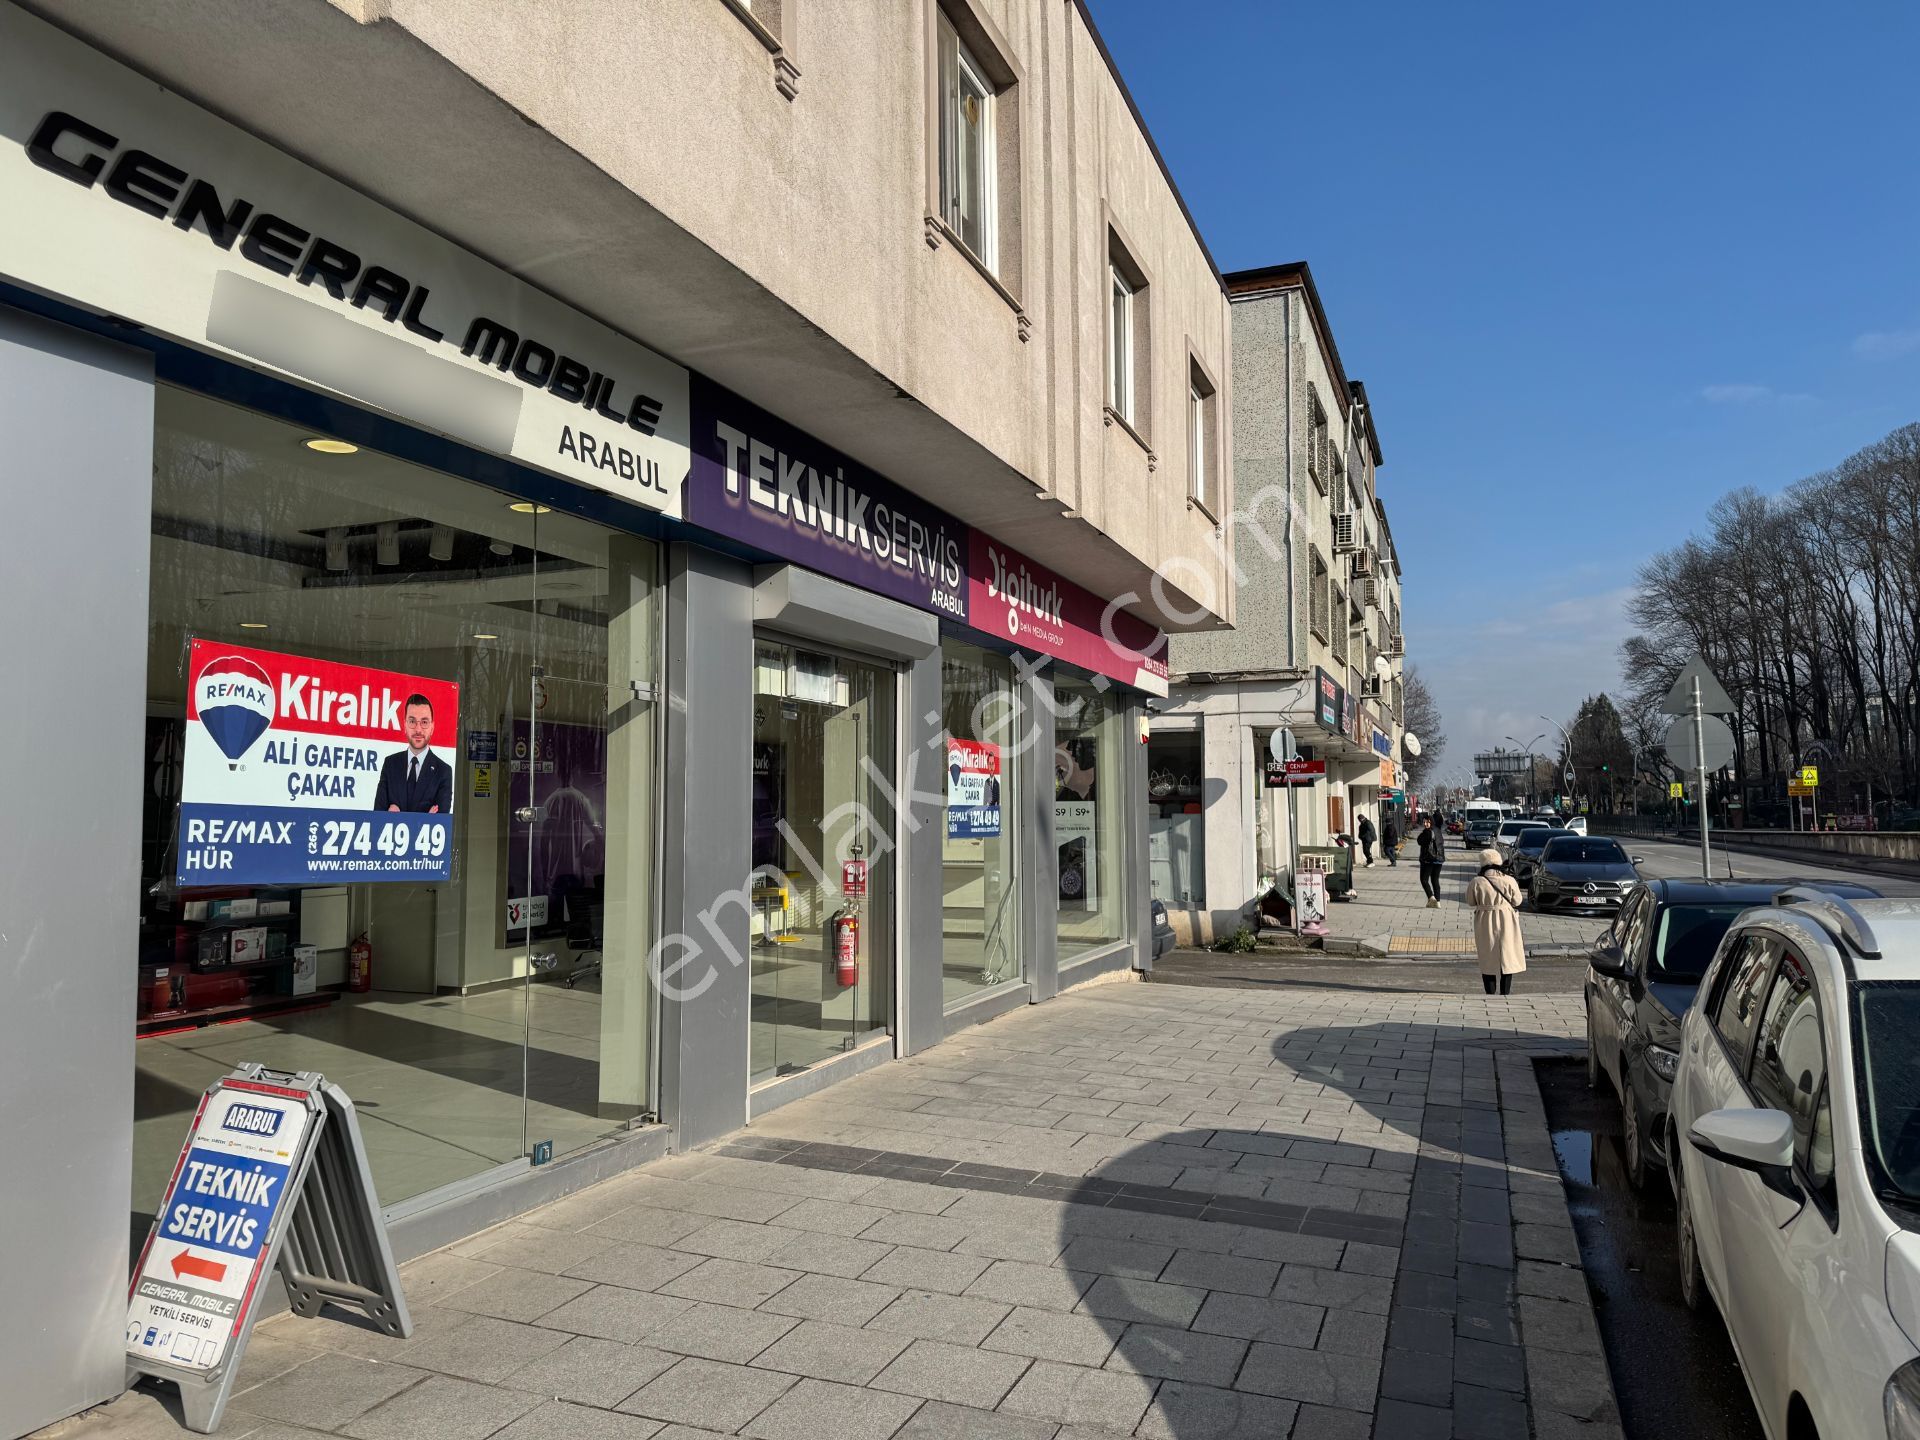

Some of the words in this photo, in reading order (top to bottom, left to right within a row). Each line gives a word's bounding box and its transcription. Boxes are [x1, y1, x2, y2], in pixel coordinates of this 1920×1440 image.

[25, 111, 443, 343] GENERAL
[461, 317, 663, 436] MOBILE
[558, 426, 668, 494] ARABUL
[716, 419, 871, 550] TEKNİK
[873, 503, 960, 588] SERVİS
[931, 588, 965, 617] ARABUL
[985, 546, 1063, 635] Digiturk
[1032, 626, 1048, 641] MEDIA
[1048, 633, 1064, 646] GROUP
[206, 683, 266, 706] RE/MAX
[280, 672, 402, 731] Kiralık
[263, 737, 298, 766] ALİ
[304, 743, 378, 772] GAFFAR
[963, 748, 988, 770] Kiralık
[287, 772, 355, 801] ÇAKAR
[187, 819, 292, 845] RE/MAX
[321, 821, 372, 857] 274
[377, 822, 409, 857] 49
[415, 823, 446, 857] 49
[186, 846, 233, 870] HÜR
[307, 857, 444, 871] www.remax.com.tr/hur
[225, 1106, 278, 1134] ARABUL
[184, 1161, 278, 1207] TEKNİK
[168, 1204, 258, 1250] SERVİS
[140, 1282, 189, 1304] GENERAL
[190, 1294, 235, 1315] MOBILE
[149, 1304, 180, 1320] YETKİLİ
[180, 1312, 213, 1330] SERVİSİ
